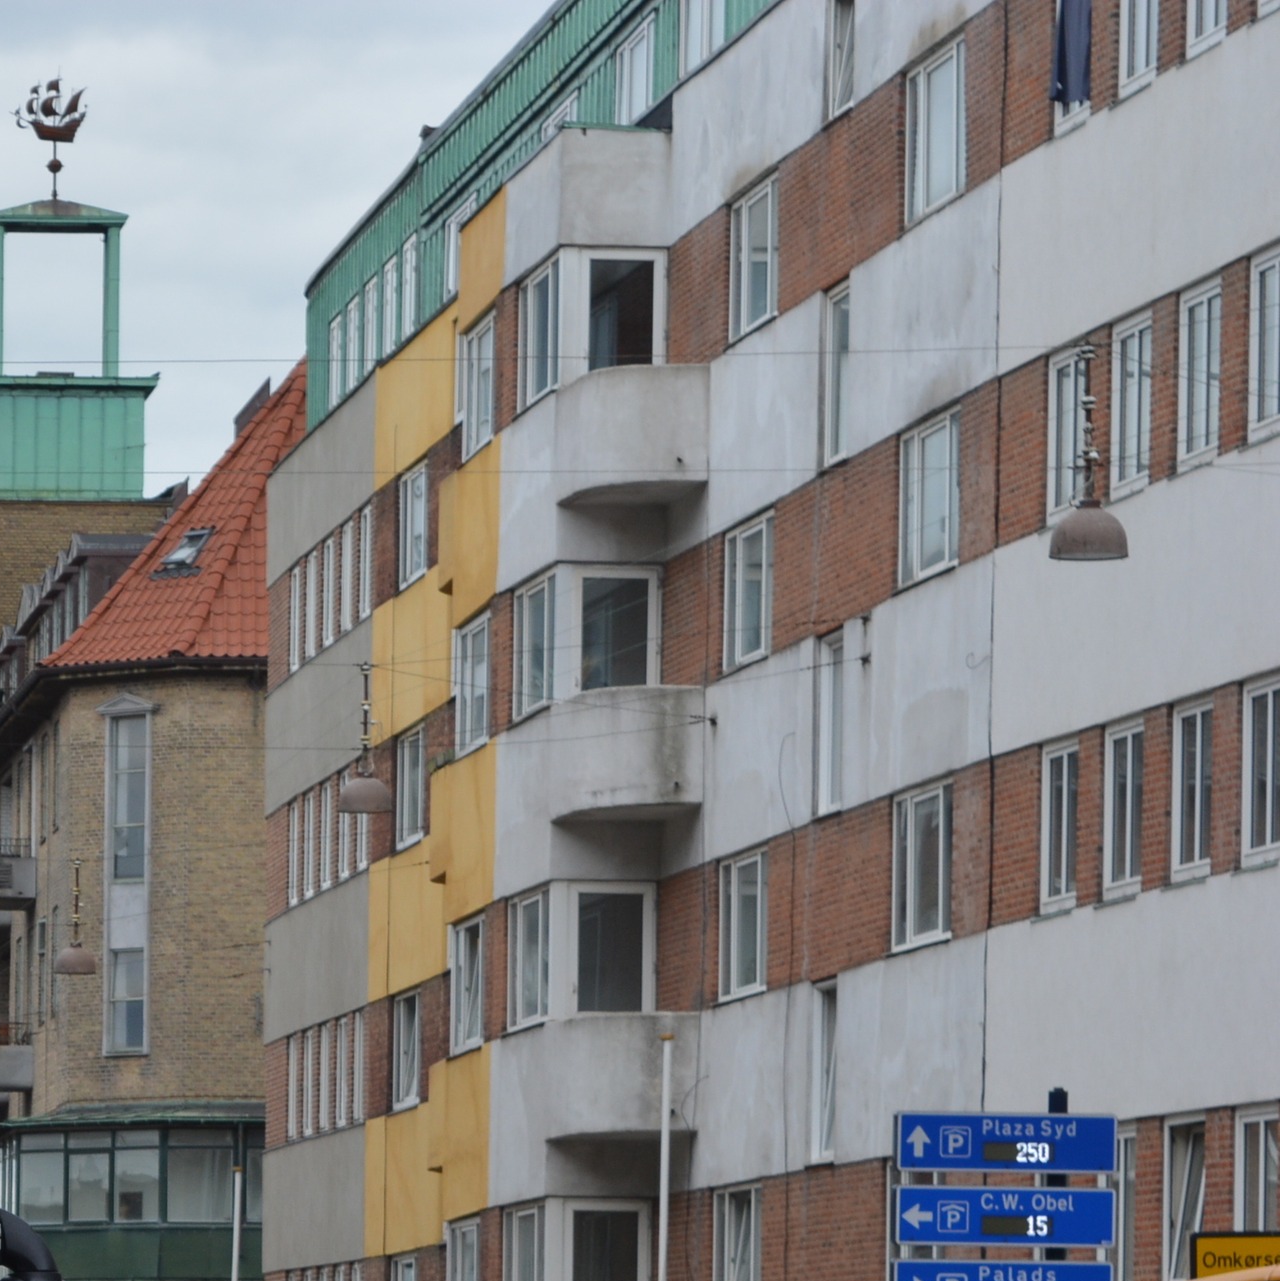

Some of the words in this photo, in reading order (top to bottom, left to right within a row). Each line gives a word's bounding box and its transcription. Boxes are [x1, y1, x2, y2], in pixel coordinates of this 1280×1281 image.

[981, 1119, 1035, 1137] Plaza
[1040, 1119, 1077, 1140] Syd
[1015, 1141, 1050, 1163] 250
[980, 1192, 1024, 1211] C.W.
[1031, 1193, 1075, 1212] Obel
[1026, 1214, 1049, 1237] 15
